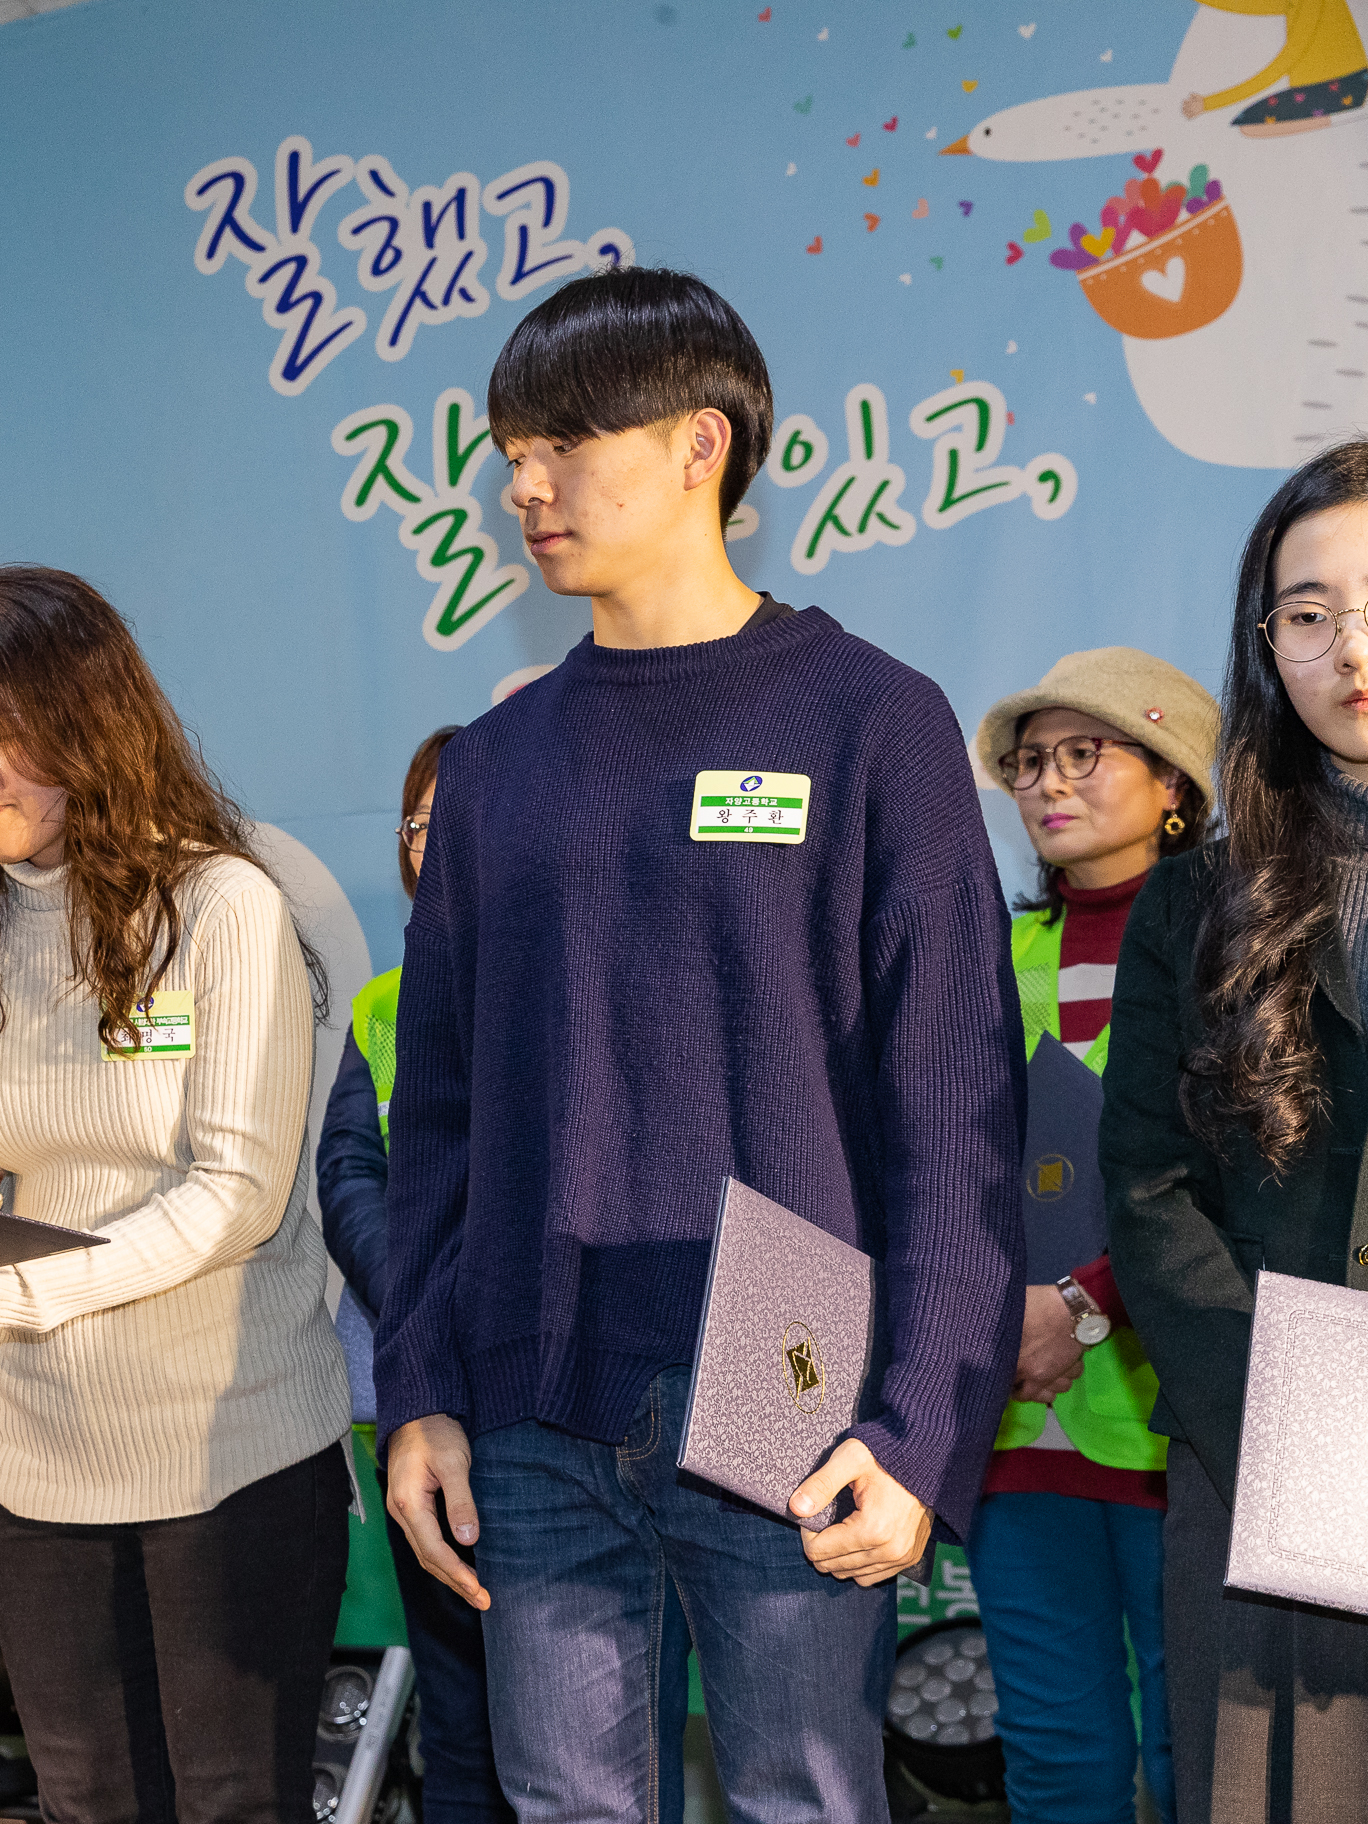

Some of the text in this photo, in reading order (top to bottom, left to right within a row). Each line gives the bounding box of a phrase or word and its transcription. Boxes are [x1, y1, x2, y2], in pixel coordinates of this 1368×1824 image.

[195, 150, 624, 381] 잘했고,
[781, 394, 1063, 560] 있고,
[725, 797, 778, 806] 자양고등학교
